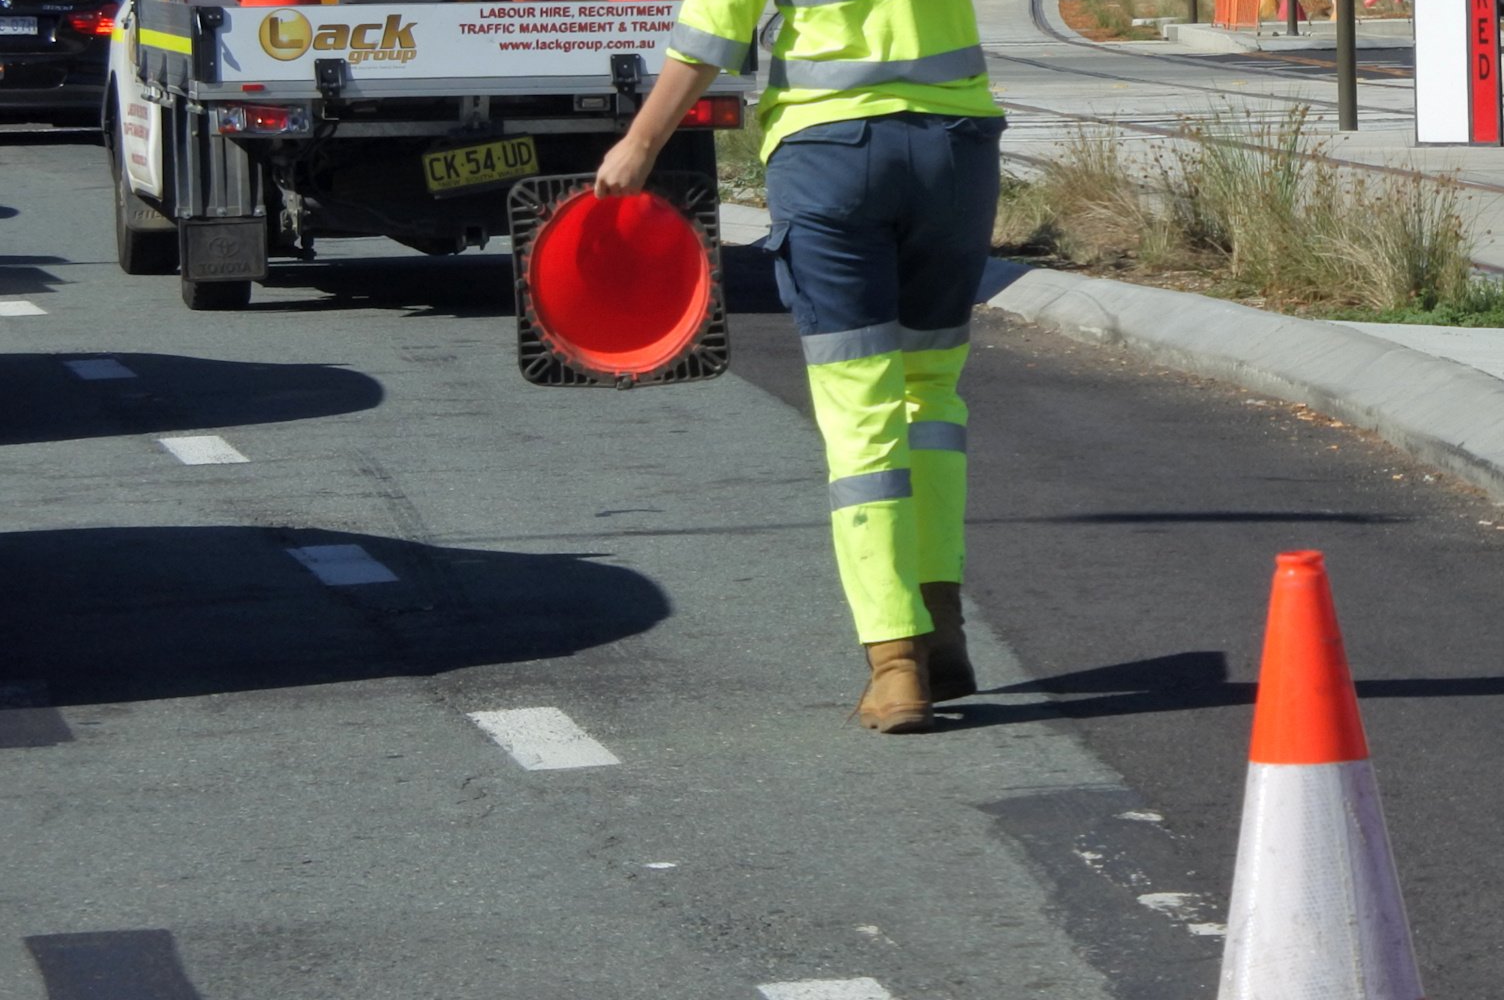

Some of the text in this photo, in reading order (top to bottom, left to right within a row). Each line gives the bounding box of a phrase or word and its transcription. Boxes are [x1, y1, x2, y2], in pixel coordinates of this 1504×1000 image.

[480, 5, 673, 19] LABOUR HIRE, RECRUITMENT
[267, 13, 418, 51] Lack
[459, 22, 515, 35] TRAFFIC
[519, 21, 615, 34] MANAGEMENT
[618, 21, 627, 33] &
[499, 38, 656, 53] www.lackgroup.com.au
[348, 50, 418, 65] group
[198, 262, 252, 274] TOYOTA
